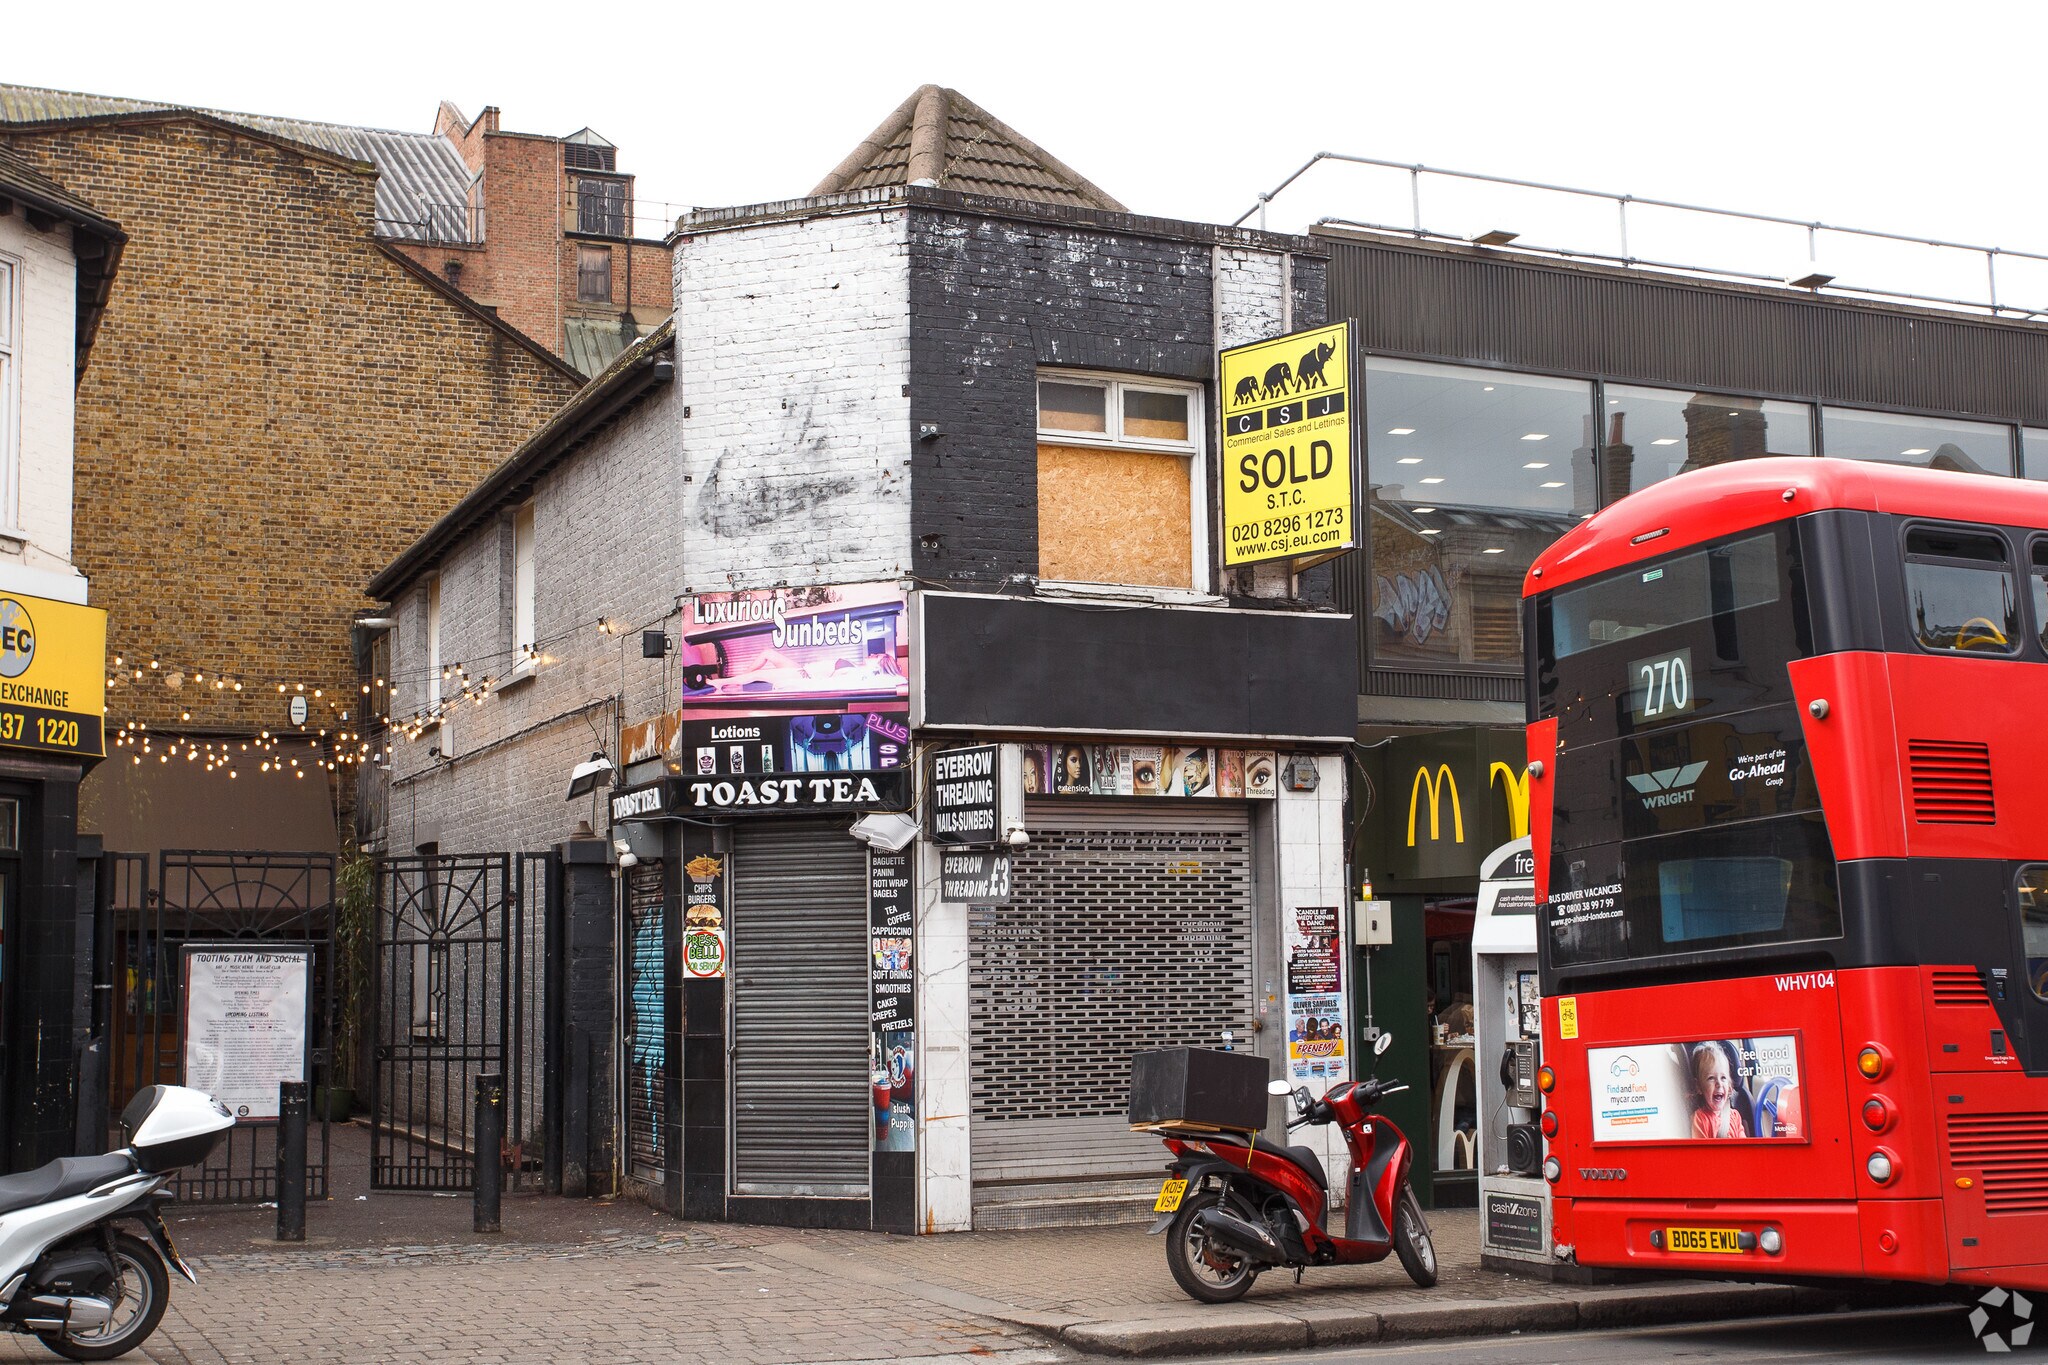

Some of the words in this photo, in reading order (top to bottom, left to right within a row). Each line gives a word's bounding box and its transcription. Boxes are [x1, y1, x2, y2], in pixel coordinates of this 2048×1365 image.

[1239, 416, 1250, 432] C
[1280, 407, 1290, 424] S
[1322, 397, 1330, 414] J
[1227, 431, 1272, 448] Commercial
[1274, 426, 1295, 440] Sales
[1297, 422, 1311, 435] and
[1314, 416, 1345, 431] Lettings
[1239, 439, 1333, 493] SOLD
[1267, 489, 1306, 510] S.T.C.
[1232, 523, 1259, 542] 020
[1264, 515, 1301, 537] 8296
[1306, 507, 1343, 530] 1273
[1236, 528, 1340, 557] www.csj.eu.com
[771, 600, 863, 648] Sunbeds
[1641, 657, 1688, 717] 270
[2, 683, 68, 708] EXCHANGE
[0, 712, 25, 740] 37
[37, 717, 78, 746] 1220
[711, 725, 760, 739] Lotions
[866, 713, 908, 741] PLUS
[1738, 755, 1753, 764] We're
[1755, 753, 1767, 763] part
[1769, 750, 1776, 759] of
[1776, 749, 1786, 758] the
[936, 751, 992, 780] EYEBROW
[1729, 759, 1785, 781] Go-Ahead
[1766, 778, 1784, 786] Group
[691, 779, 801, 806] TOAST
[809, 778, 879, 803] TEA
[936, 779, 993, 807] THREADING
[1246, 786, 1275, 796] Threading
[613, 791, 640, 819] TOAST
[641, 787, 661, 813] TEA
[1642, 790, 1695, 809] WRIGHT
[873, 857, 905, 866] BAGUETTE
[873, 868, 894, 877] PANINI
[945, 856, 983, 874] EYEBROW
[989, 857, 1009, 897] £3
[694, 884, 712, 893] CHIPS
[873, 879, 888, 888] ROTI
[889, 879, 908, 887] WRAP
[945, 880, 988, 898] THREADING
[688, 895, 716, 904] BURGERS
[873, 889, 897, 898] BAGELS
[1548, 895, 1560, 904] BUS
[1561, 890, 1584, 901] DRIVER
[1584, 884, 1622, 897] VACANCIES
[884, 905, 898, 915] TEA
[1567, 904, 1581, 914] 0800
[1582, 902, 1590, 911] 38
[1591, 901, 1599, 910] 99
[1600, 899, 1604, 908] 7
[1605, 898, 1614, 907] 99
[887, 912, 911, 926] COFFEE
[1551, 909, 1623, 927] www.go-ahead-london.com
[872, 927, 912, 936] CAPPUCCINO
[686, 934, 718, 946] PRESS
[197, 954, 230, 963] TOOTING
[234, 954, 253, 962] TRAM
[256, 954, 271, 963] AND
[274, 954, 301, 963] SOCIAL
[873, 970, 888, 979] SOFT
[889, 970, 912, 979] DRINKS
[876, 984, 911, 993] SMOOTHIES
[1775, 973, 1834, 992] WHV104
[877, 997, 898, 1009] CAKES
[1293, 1001, 1312, 1009] OLIVER
[1312, 1000, 1337, 1008] SAMUELS
[872, 1009, 897, 1021] CREPES
[881, 1018, 913, 1032] PRETZELS
[1297, 1040, 1337, 1053] FRENEMY
[1739, 1047, 1758, 1061] feel
[1762, 1045, 1789, 1062] good
[1737, 1065, 1753, 1077] car
[1757, 1062, 1793, 1078] buying
[1610, 1095, 1645, 1105] mycar.com
[893, 1103, 911, 1114] slush
[891, 1117, 914, 1131] Puppie
[1279, 1168, 1311, 1195] HONDA
[1579, 1168, 1627, 1181] VOLVO
[1160, 1195, 1178, 1208] VSM
[1673, 1230, 1707, 1248] BD65
[1710, 1231, 1737, 1249] EWU
